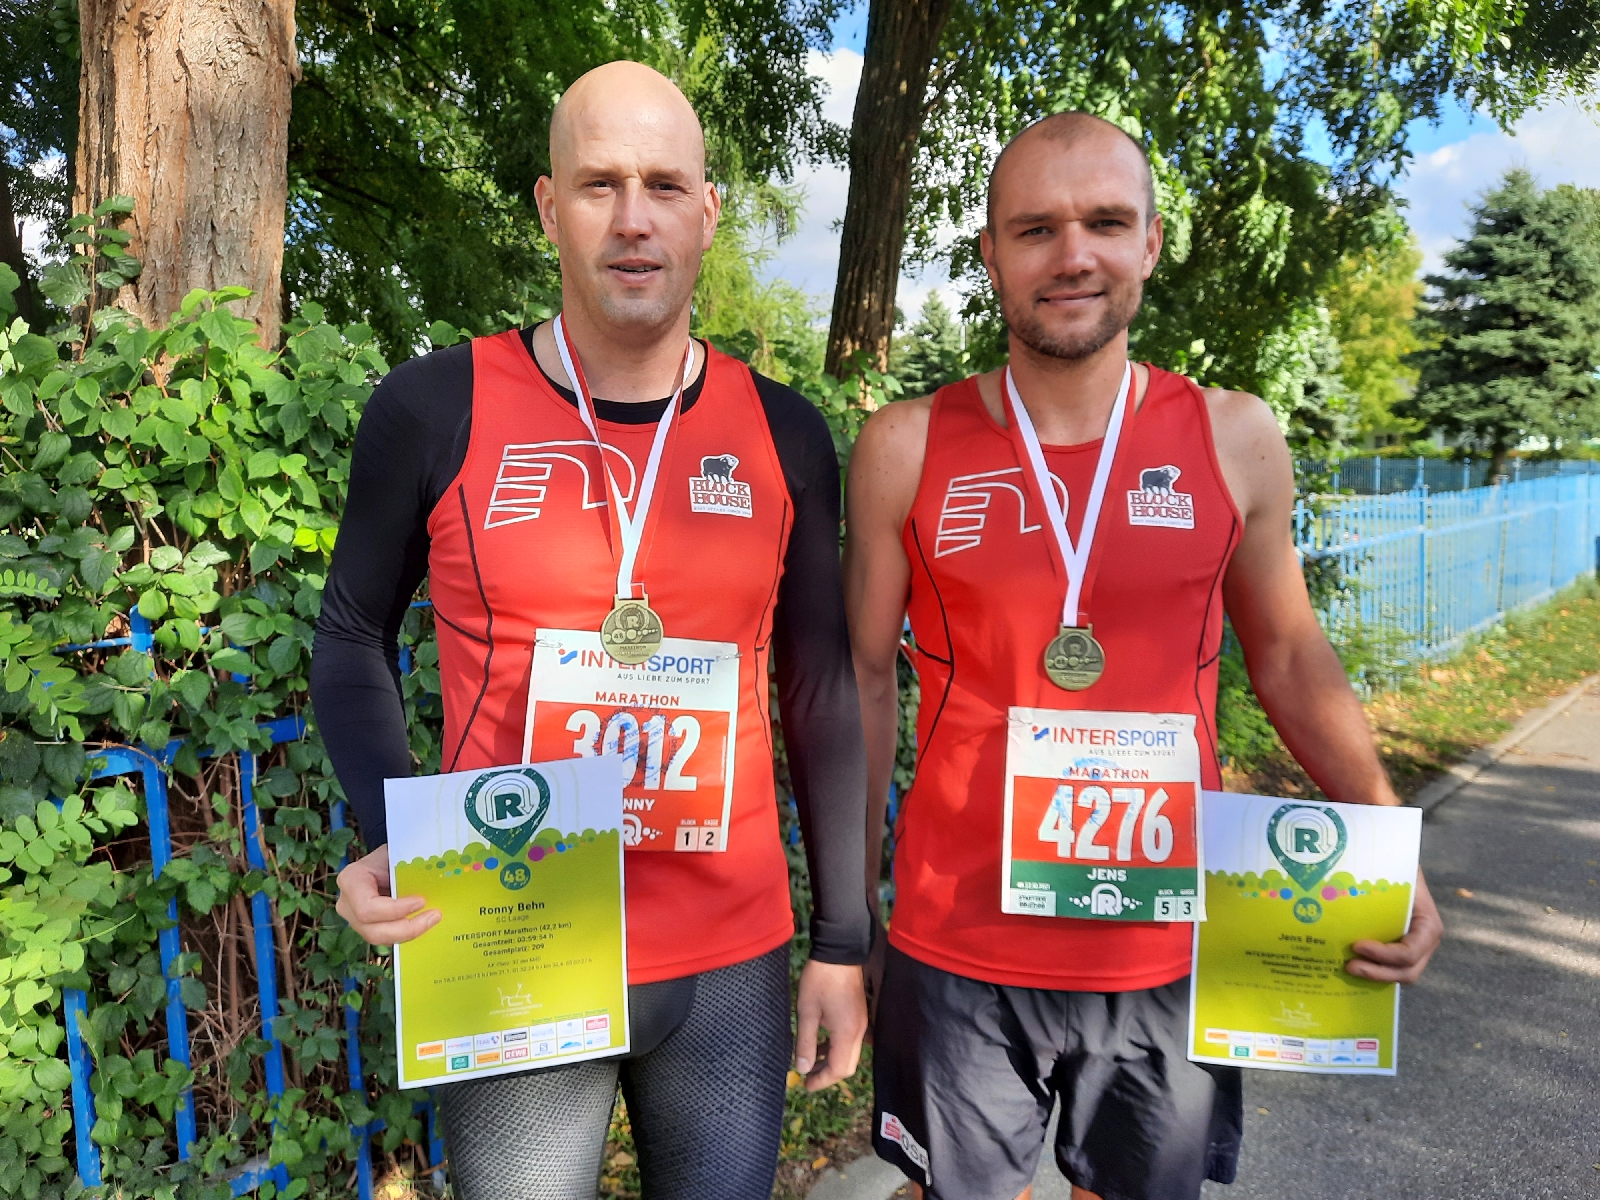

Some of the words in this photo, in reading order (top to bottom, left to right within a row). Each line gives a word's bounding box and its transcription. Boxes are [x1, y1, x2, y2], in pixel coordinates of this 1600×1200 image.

[692, 479, 749, 496] BLOCK
[693, 492, 750, 509] HOUSE
[1130, 492, 1191, 507] BLOCK
[1131, 505, 1192, 520] HOUSE
[638, 674, 662, 682] LIEBE
[665, 675, 682, 683] ZUM
[685, 676, 710, 684] SPORT
[595, 691, 680, 706] MARATHON
[1053, 727, 1178, 747] INTERSPORT
[565, 709, 701, 791] 3012
[1069, 766, 1149, 779] MARATHON
[494, 792, 525, 820] R
[1038, 784, 1174, 864] 4276
[684, 832, 690, 846] 1
[705, 832, 714, 846] 2
[1294, 828, 1321, 853] R
[503, 868, 527, 884] 48
[1087, 868, 1127, 882] JENS
[479, 904, 514, 917] Ronny
[517, 901, 545, 912] Behn
[1161, 901, 1170, 915] 5
[1183, 901, 1191, 915] 3
[453, 929, 502, 942] INTERSPORT
[503, 926, 538, 936] Marathon
[1279, 933, 1302, 942] Jens
[1306, 935, 1326, 945] Beu
[472, 938, 515, 949] Gesamtzeit:
